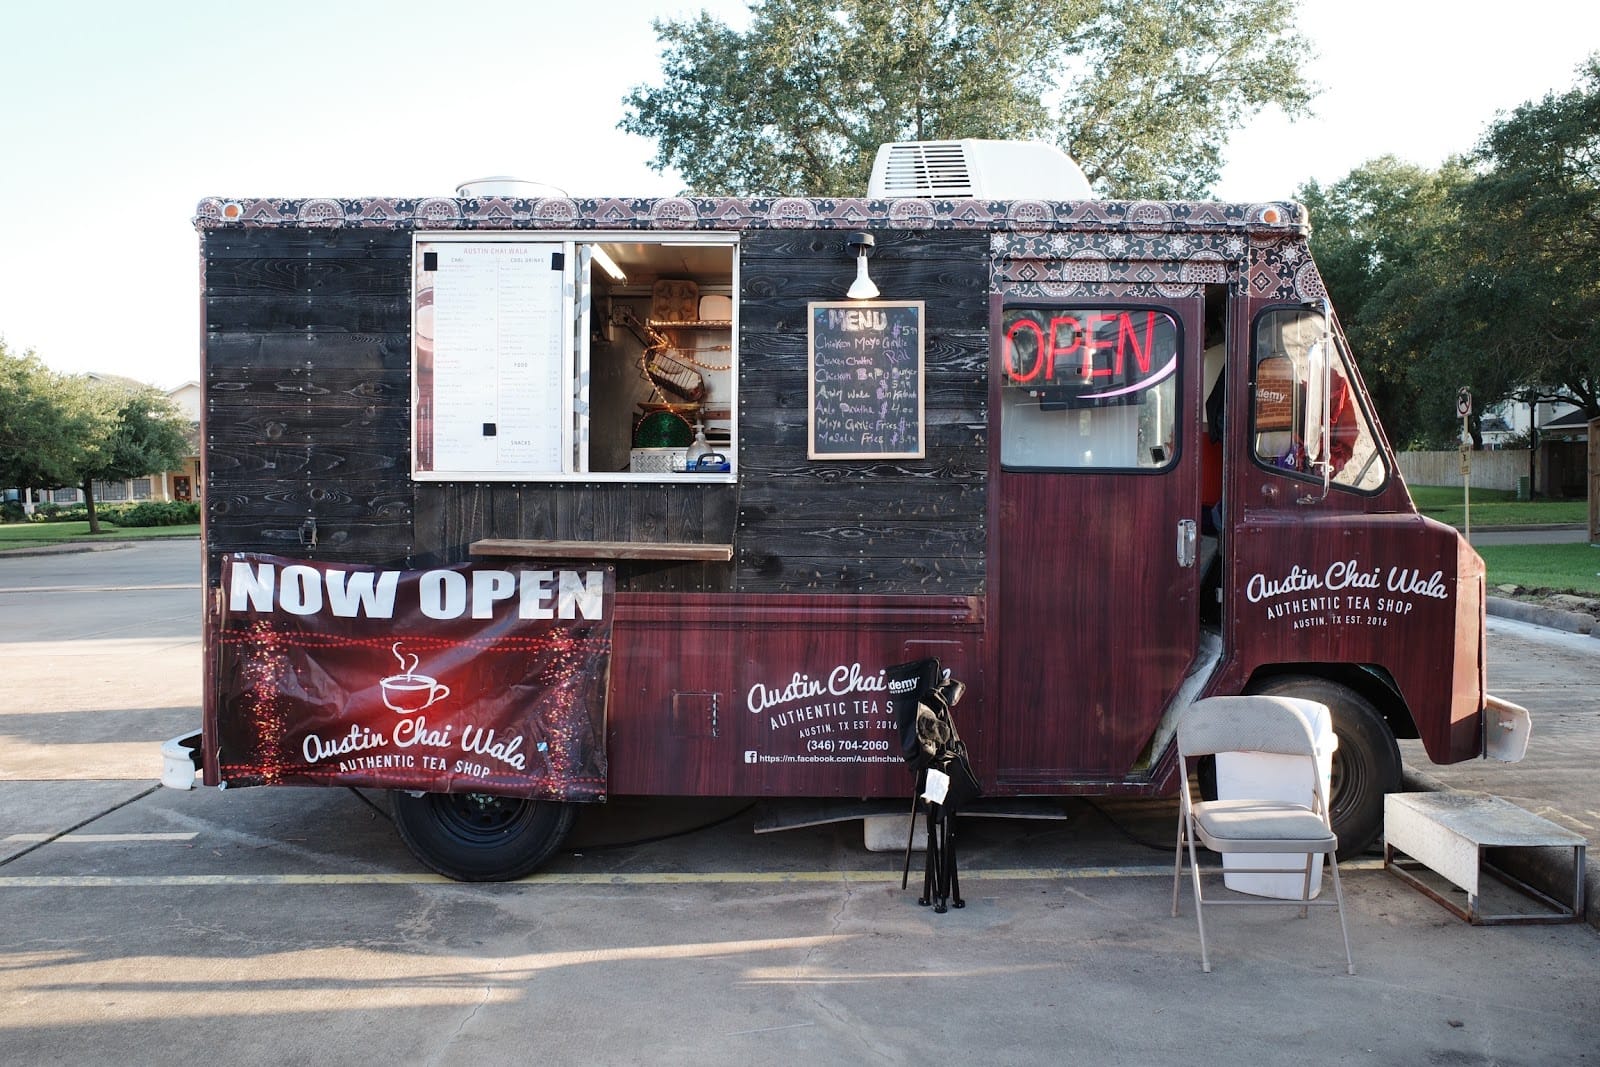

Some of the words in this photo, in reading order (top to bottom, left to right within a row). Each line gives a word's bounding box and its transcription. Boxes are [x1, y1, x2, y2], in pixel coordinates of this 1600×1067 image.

[828, 309, 887, 331] MENU
[1004, 310, 1156, 383] OPEN
[230, 562, 400, 619] NOW
[419, 569, 604, 620] OPEN
[1246, 565, 1323, 602] Austin
[1324, 559, 1381, 590] Chai
[1386, 566, 1448, 599] Wala
[1267, 597, 1340, 620] AUTHENTIC
[1347, 596, 1371, 610] TEA
[1377, 598, 1413, 615] SHOP
[1332, 615, 1342, 624] TX
[1345, 615, 1363, 624] EST.
[1367, 616, 1388, 627] 2016
[747, 671, 827, 713] Austin
[828, 662, 887, 696] Chai
[770, 702, 847, 730] AUTHENTIC
[854, 700, 879, 714] TEA
[839, 721, 850, 731] TX
[853, 720, 872, 730] EST.
[876, 720, 898, 730] 2016
[302, 725, 388, 764] Austin
[392, 716, 452, 748] Chai
[460, 725, 527, 771] Wala
[807, 741, 835, 752] (346)
[838, 741, 889, 750] 704-2060
[339, 755, 415, 773] AUTHENTIC
[422, 756, 448, 771] TEA
[454, 759, 490, 779] SHOP
